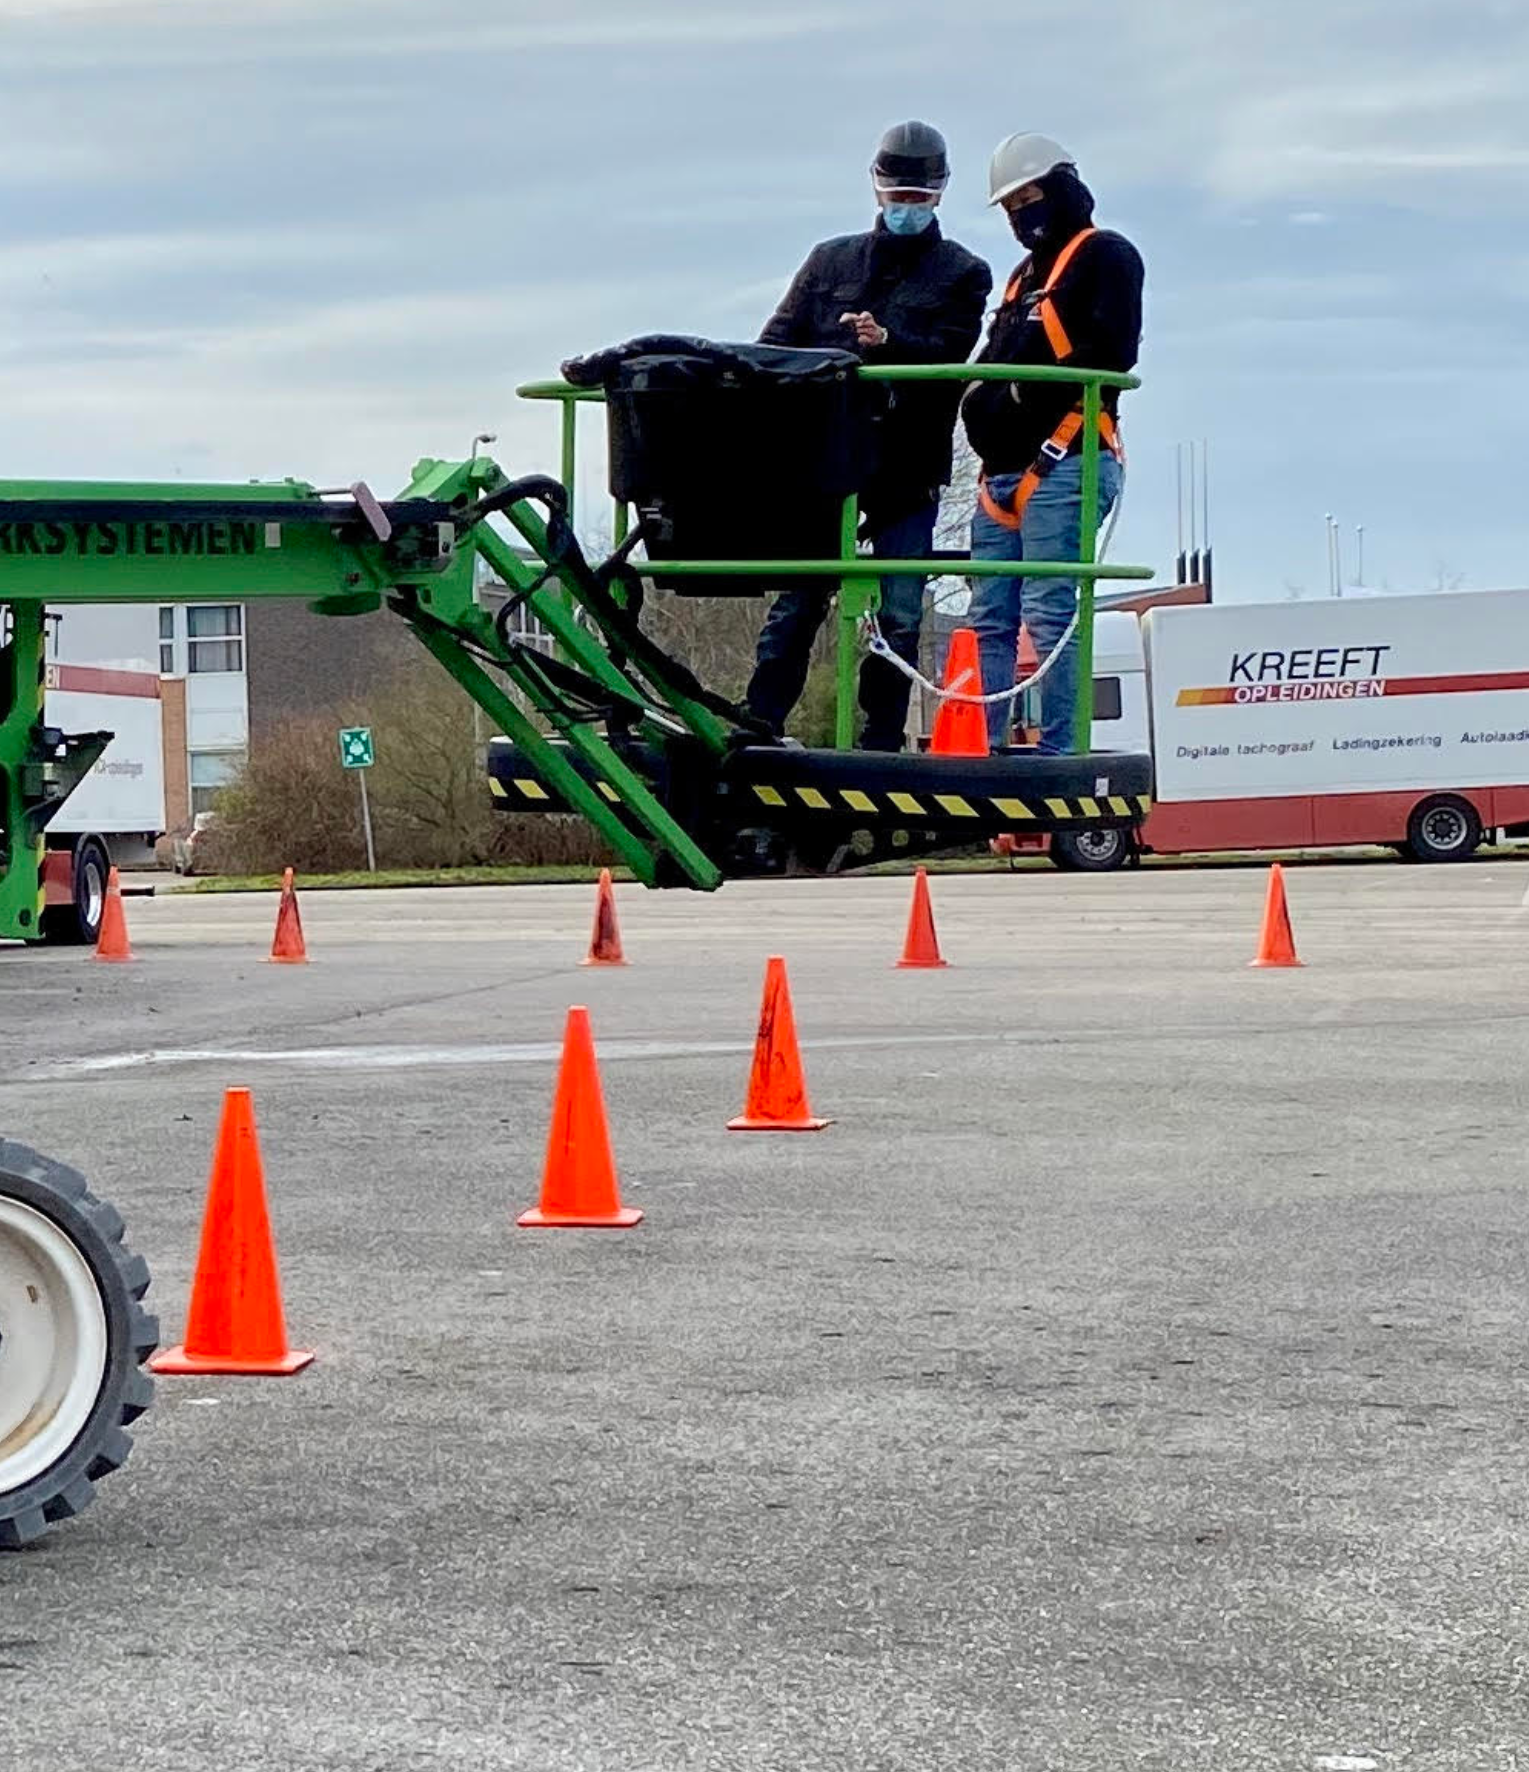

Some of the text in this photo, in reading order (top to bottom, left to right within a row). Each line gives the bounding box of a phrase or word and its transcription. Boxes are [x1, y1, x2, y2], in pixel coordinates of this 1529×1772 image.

[1228, 645, 1391, 683] KREEFT
[1233, 679, 1386, 704] OPLEIDINGEN
[1176, 744, 1230, 759] Digitale
[1237, 740, 1315, 756] tachograaf
[1332, 734, 1442, 751] Ladingzekering
